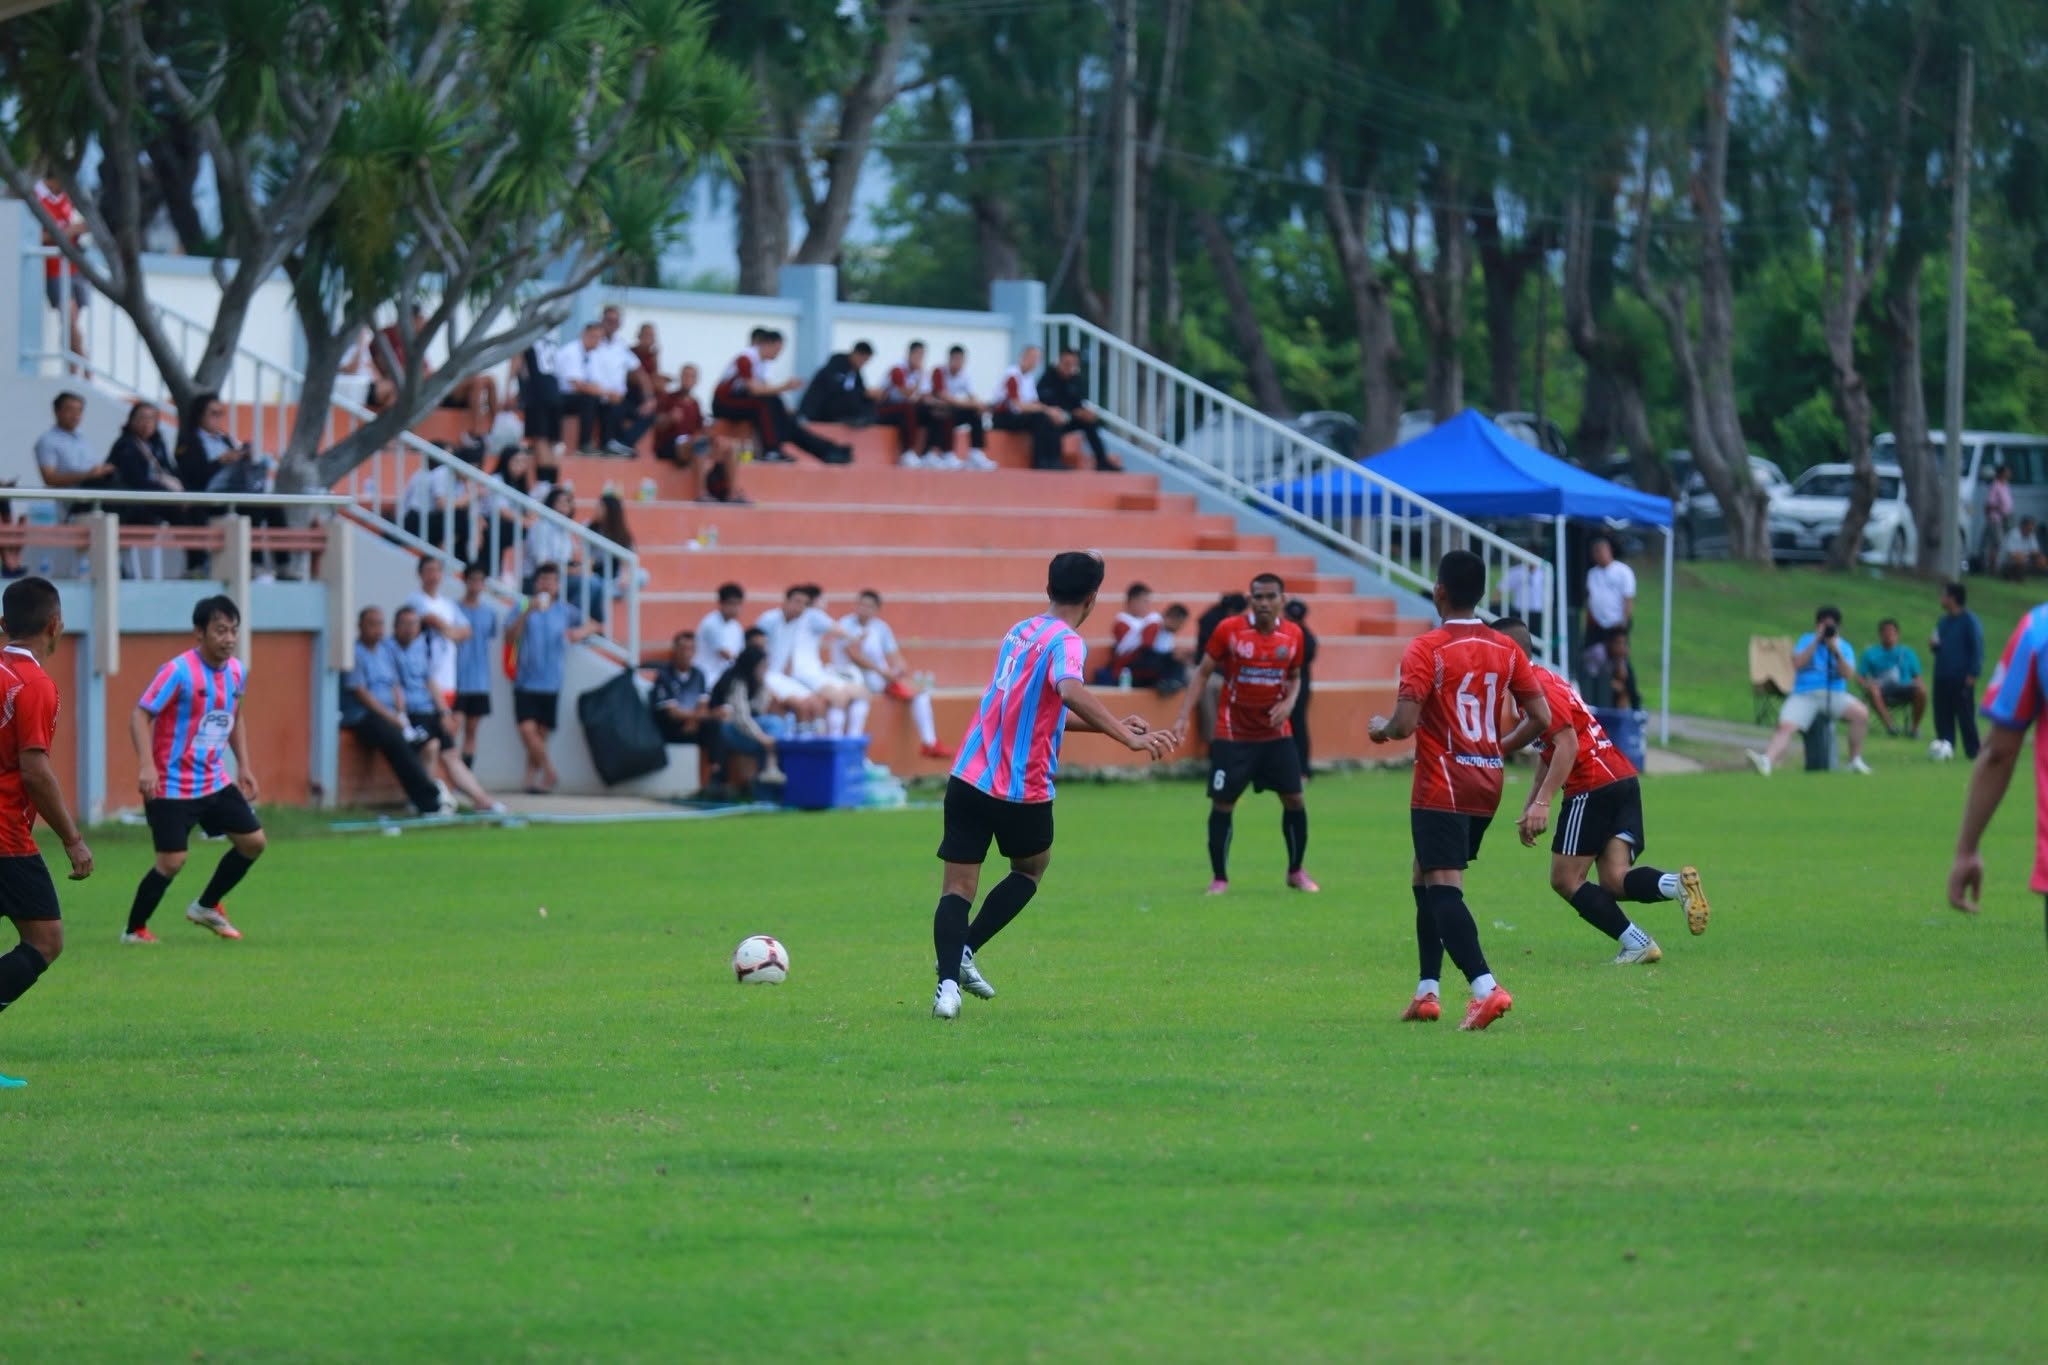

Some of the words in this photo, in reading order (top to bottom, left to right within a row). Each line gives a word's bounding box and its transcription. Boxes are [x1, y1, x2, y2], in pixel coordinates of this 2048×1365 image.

[1456, 672, 1498, 743] 61
[203, 714, 229, 728] PS
[1214, 769, 1226, 790] 6
